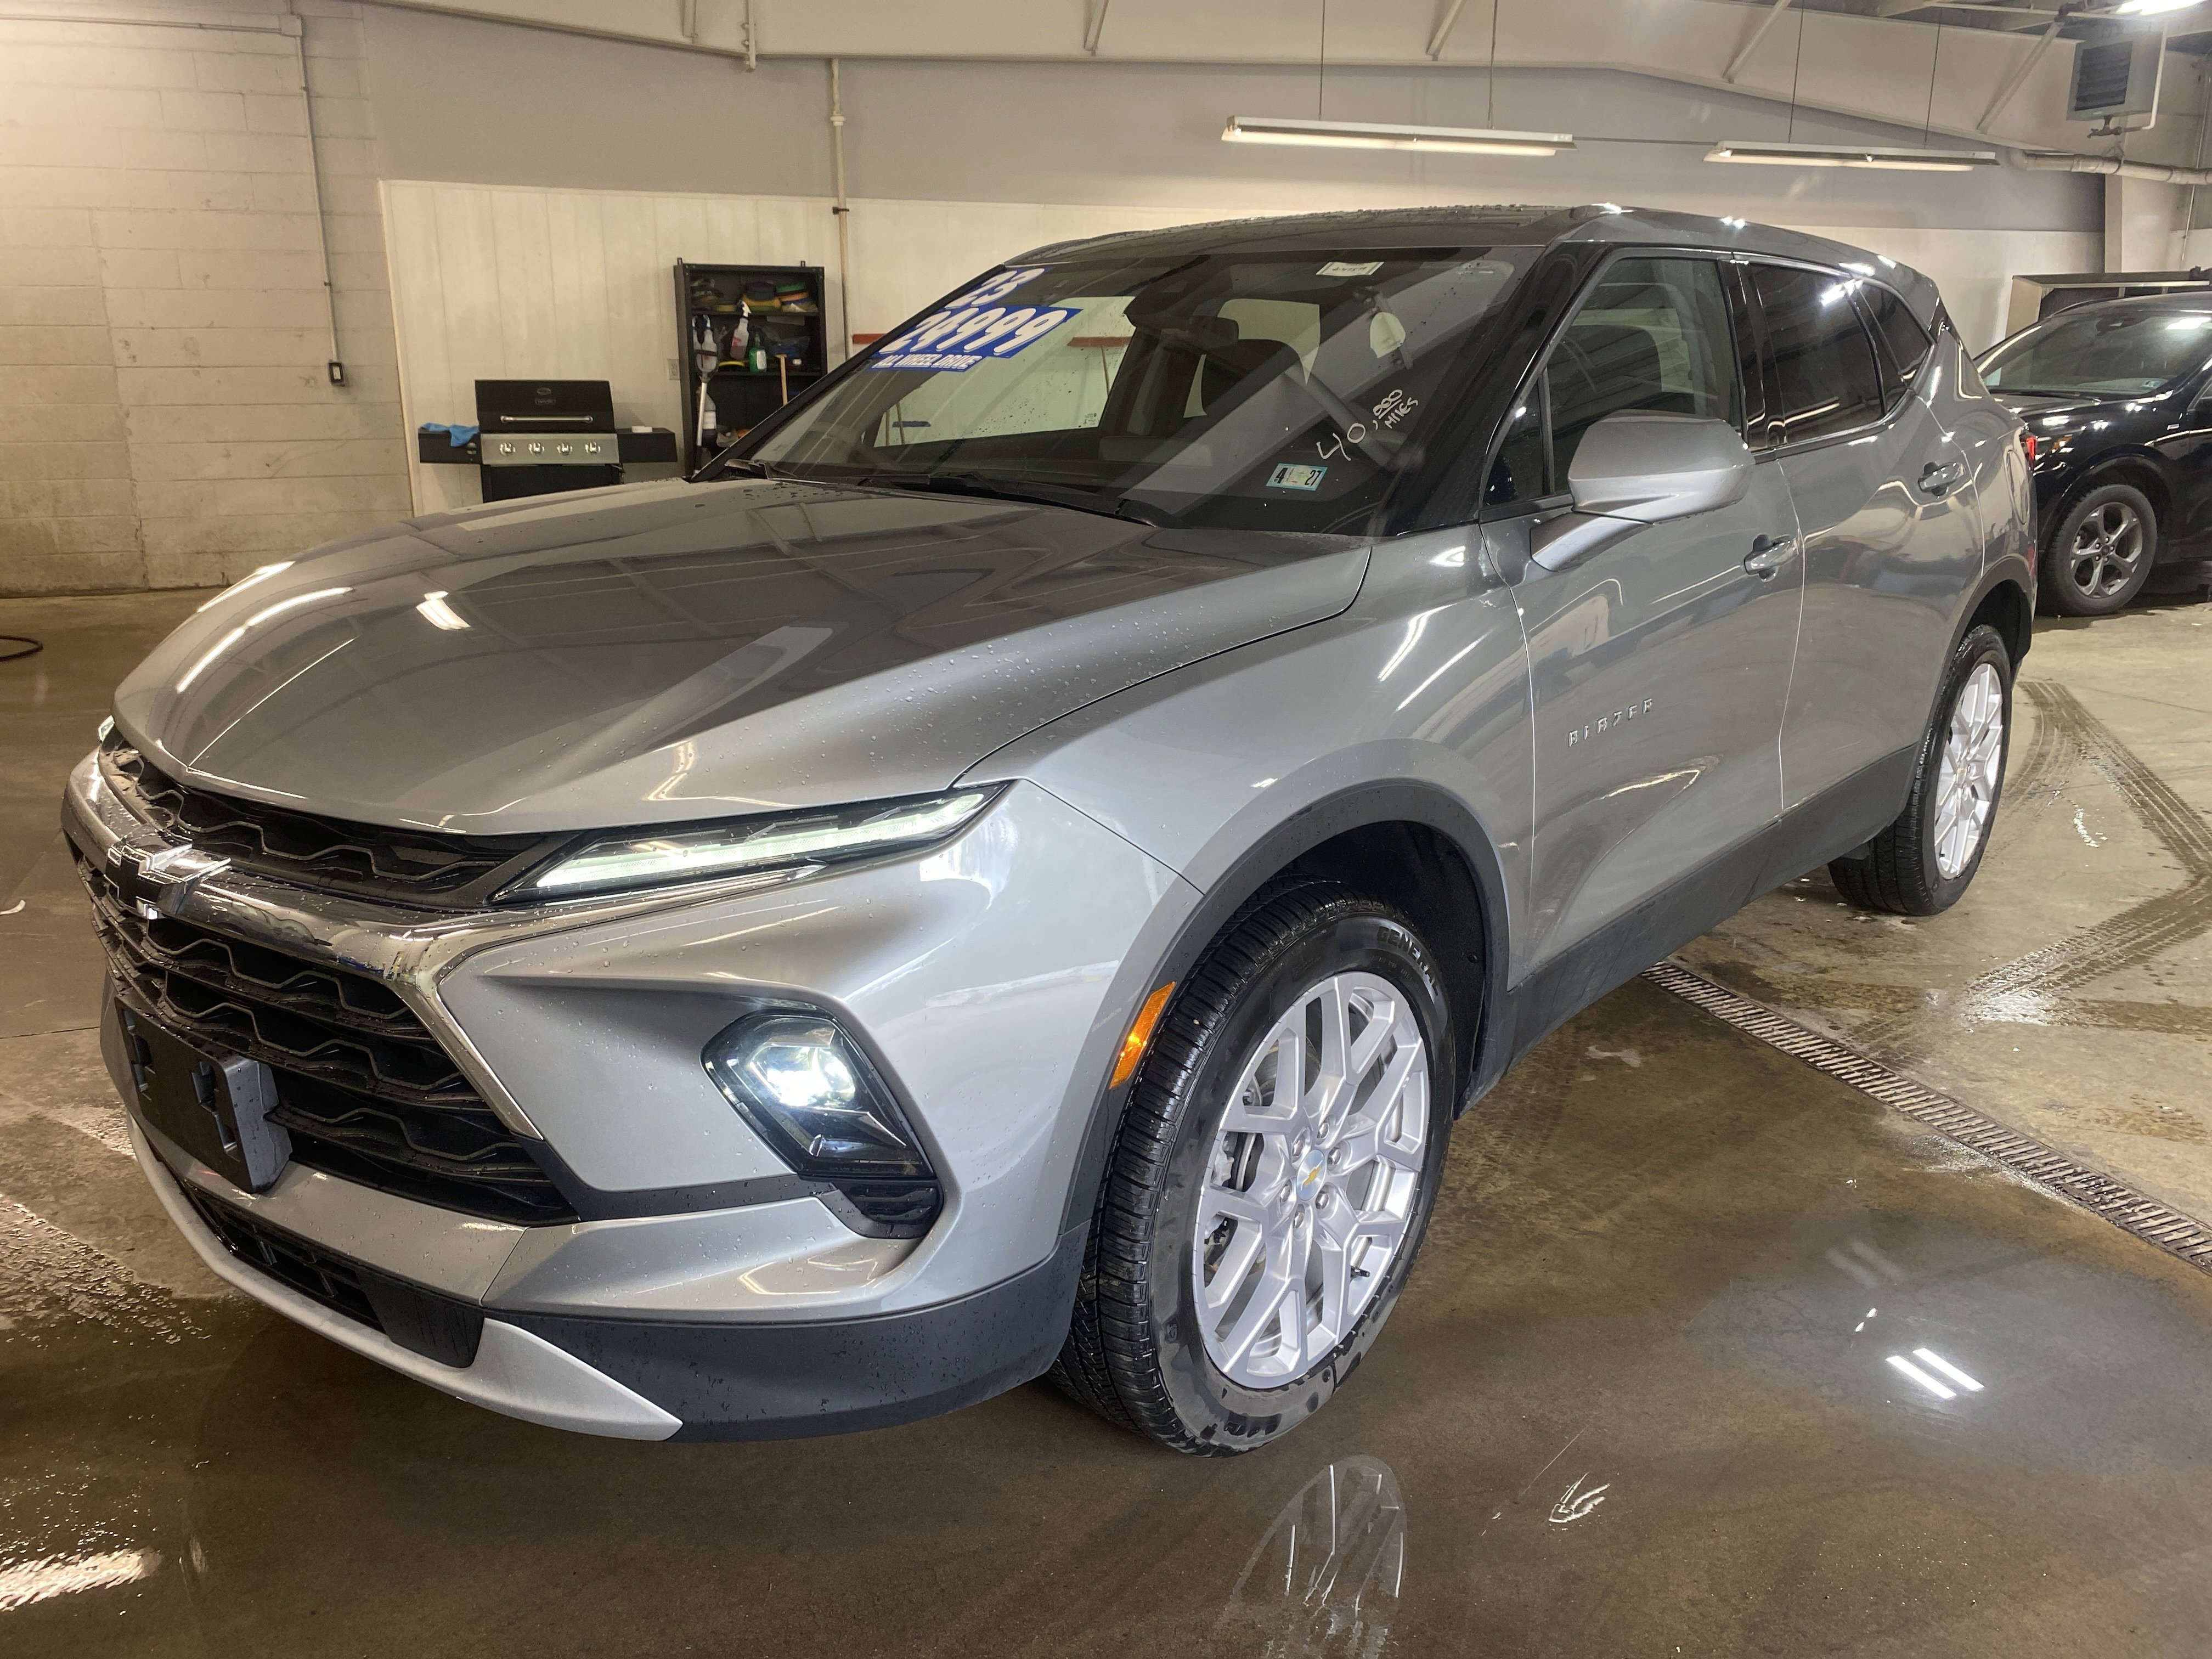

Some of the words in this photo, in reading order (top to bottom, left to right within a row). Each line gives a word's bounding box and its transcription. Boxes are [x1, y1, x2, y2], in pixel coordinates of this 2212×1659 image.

[945, 268, 1045, 310] 23
[878, 307, 1068, 356] 24999
[871, 354, 904, 369] ALL
[893, 354, 943, 368] WHEEL
[931, 354, 983, 370] DRIVE
[1276, 467, 1289, 484] 4
[1304, 470, 1323, 486] 27
[1567, 698, 1653, 748] BLAZER
[1376, 926, 1439, 997] GENERAL
